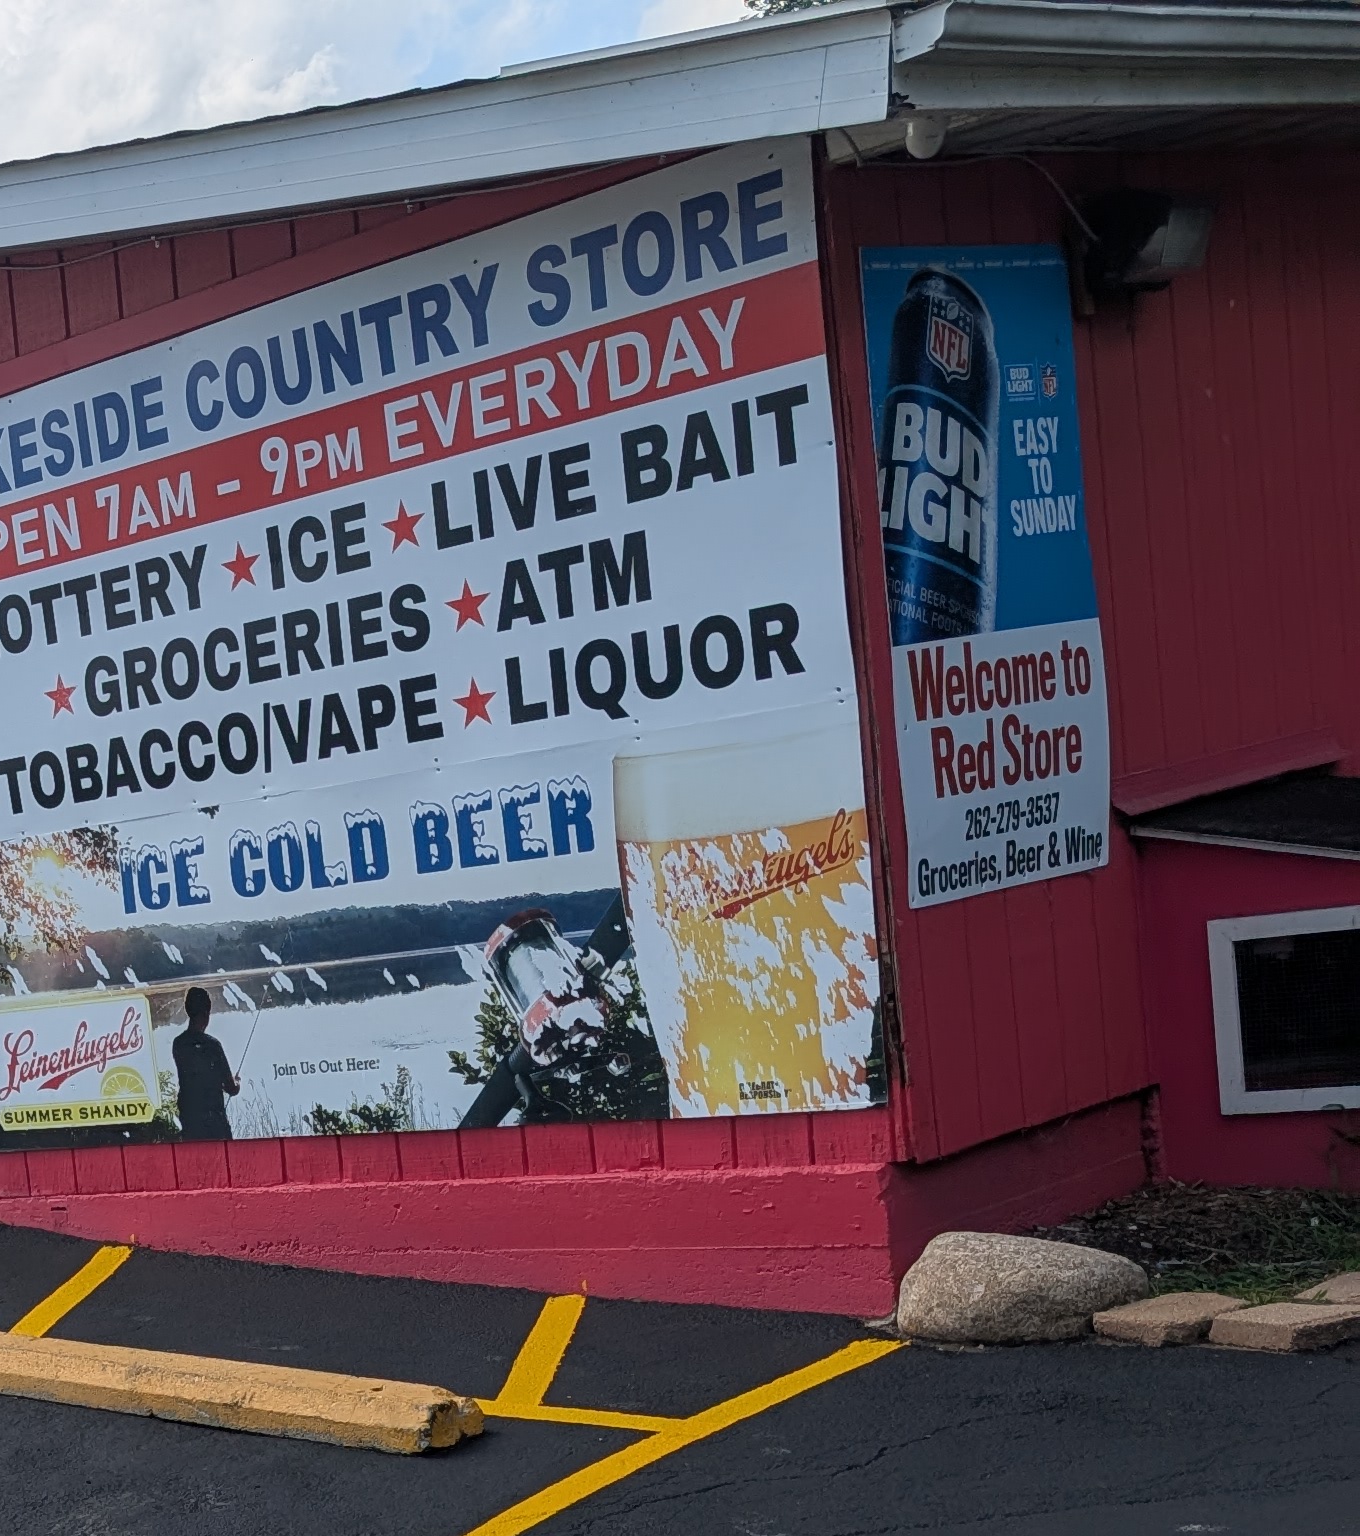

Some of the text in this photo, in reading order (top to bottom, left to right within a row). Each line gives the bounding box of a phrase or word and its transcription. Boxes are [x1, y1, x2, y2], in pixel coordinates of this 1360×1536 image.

[186, 262, 499, 432] COUNTRY
[525, 168, 788, 327] STORE
[931, 317, 968, 372] NFL
[1010, 367, 1029, 379] BUD
[96, 471, 196, 541] 7AM
[260, 425, 363, 497] 9PM
[383, 297, 746, 463] EVERYDAY
[1007, 380, 1033, 393] LIGHT
[892, 403, 988, 498] BUD
[1013, 417, 1058, 456] EASY
[266, 501, 371, 590] ICE
[432, 443, 596, 550] LIVE
[621, 384, 809, 504] BAIT
[1028, 457, 1052, 495] TO
[879, 466, 984, 564] LIGH
[1010, 495, 1076, 537] SUNDAY
[85, 530, 652, 717] GROCERIES ATM
[920, 587, 946, 609] BEER
[505, 602, 805, 725] LIQUOR
[907, 640, 1091, 721] Welcome to
[931, 714, 1083, 798] Red Store
[118, 774, 594, 914] ICE COLD BEER
[965, 792, 1060, 843] 262-279-3537
[917, 826, 1103, 898] Groceries, Beer & Wine
[273, 1064, 297, 1080] Join
[300, 1061, 316, 1074] Us
[319, 1060, 343, 1073] Out
[4, 1102, 148, 1124] SUMMER SHANDY
